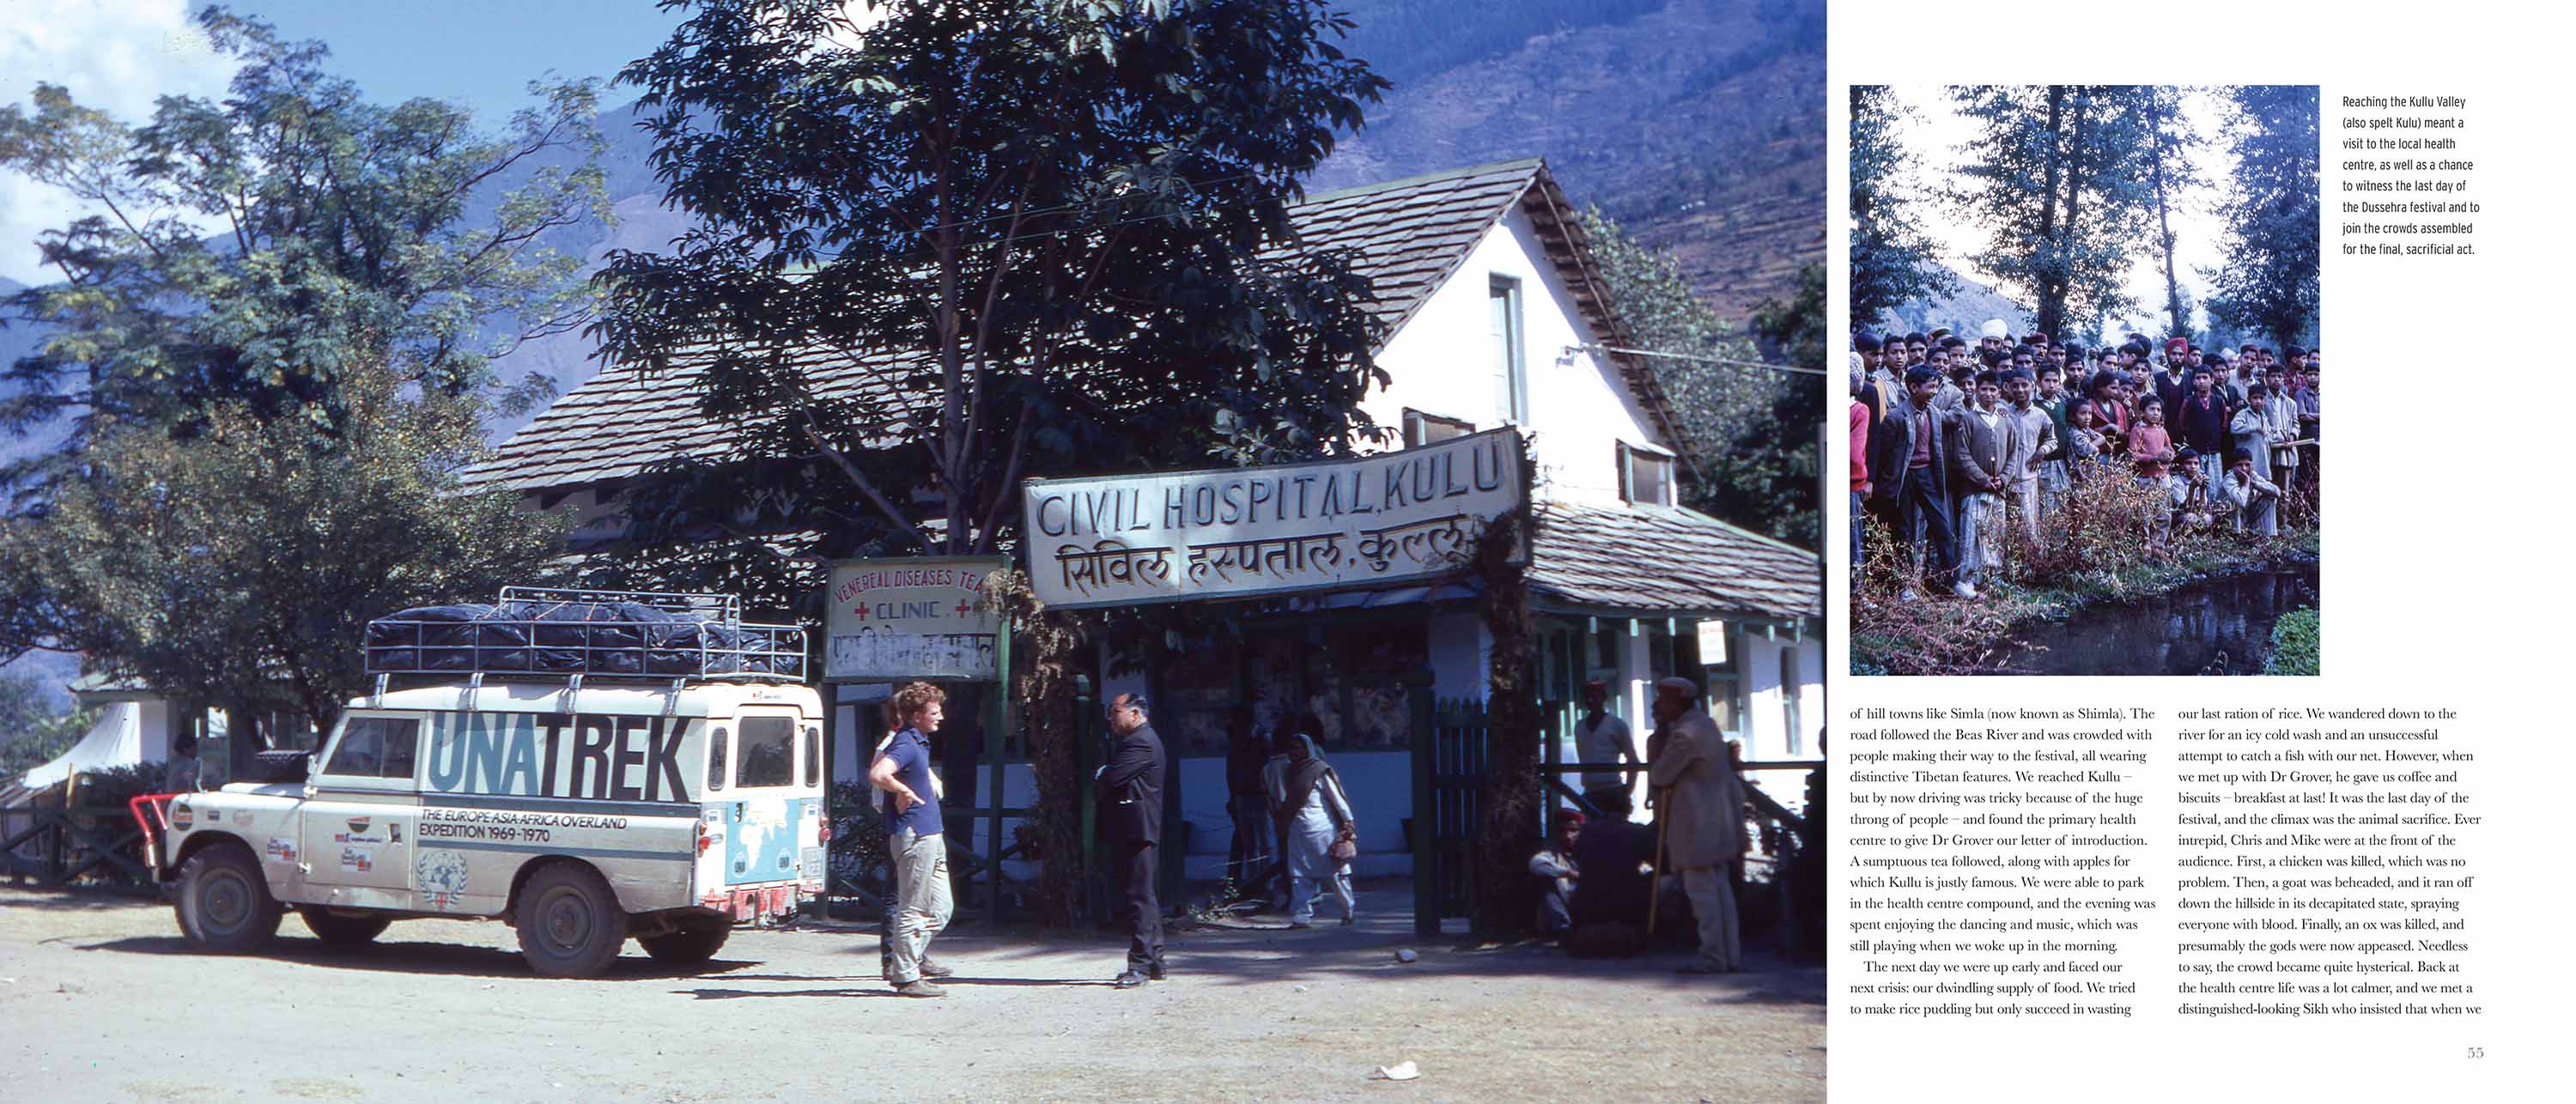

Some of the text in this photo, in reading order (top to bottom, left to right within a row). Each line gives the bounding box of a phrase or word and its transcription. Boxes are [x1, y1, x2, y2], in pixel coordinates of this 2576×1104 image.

[2342, 95, 2466, 110] Reaching the Kullu Valley
[2342, 117, 2464, 130] (also spelt Kulu) meant a
[2342, 137, 2456, 149] visit to the local health
[2342, 159, 2474, 172] centre, as well as a chance
[2342, 179, 2467, 193] to witness the last day of
[2342, 201, 2480, 213] the Dussehra festival and to
[2342, 222, 2473, 237] join the crowds assembled
[2342, 243, 2475, 256] for the final, sacrificial act.
[1037, 487, 1151, 537] CIVIL
[1384, 437, 1501, 512] KULU
[1054, 539, 1176, 597] सिविल
[834, 570, 890, 604] VENEREAL
[894, 569, 954, 588] DISEASES
[875, 600, 941, 621] CLINIC
[1850, 707, 2155, 722] of hill towns like Simla (now known as Shimla). The
[428, 711, 690, 804] UNATREK
[1850, 749, 2148, 765] people making their way to the festival, all wearing
[2178, 749, 2474, 765] attempt to catch a fish with our net. However, when
[422, 809, 442, 821] THE
[560, 816, 628, 830] OVERLAND
[419, 823, 486, 839] EXPEDITION
[1850, 834, 2148, 849] centre to give Dr Grover our letter of introduction.
[2178, 834, 2457, 850] intrepid, Chris and Mike were at the front of the
[2178, 897, 2460, 913] down the hillside in its decapitated state, spraying
[1850, 921, 1881, 934] spent
[1884, 918, 1935, 933] enjoying
[1937, 918, 1957, 930] the
[1959, 918, 2008, 933] dancing
[2009, 918, 2033, 931] and
[2036, 918, 2075, 932] music,
[2076, 918, 2112, 930] which
[2178, 939, 2469, 955] presumably the gods were now appeased. Needless
[1850, 981, 2136, 997] next crisis: our dwindling supply of food. We tried
[2178, 1002, 2482, 1018] distinguished-looking Sikh who insisted that when we
[2467, 1046, 2484, 1059] 55
